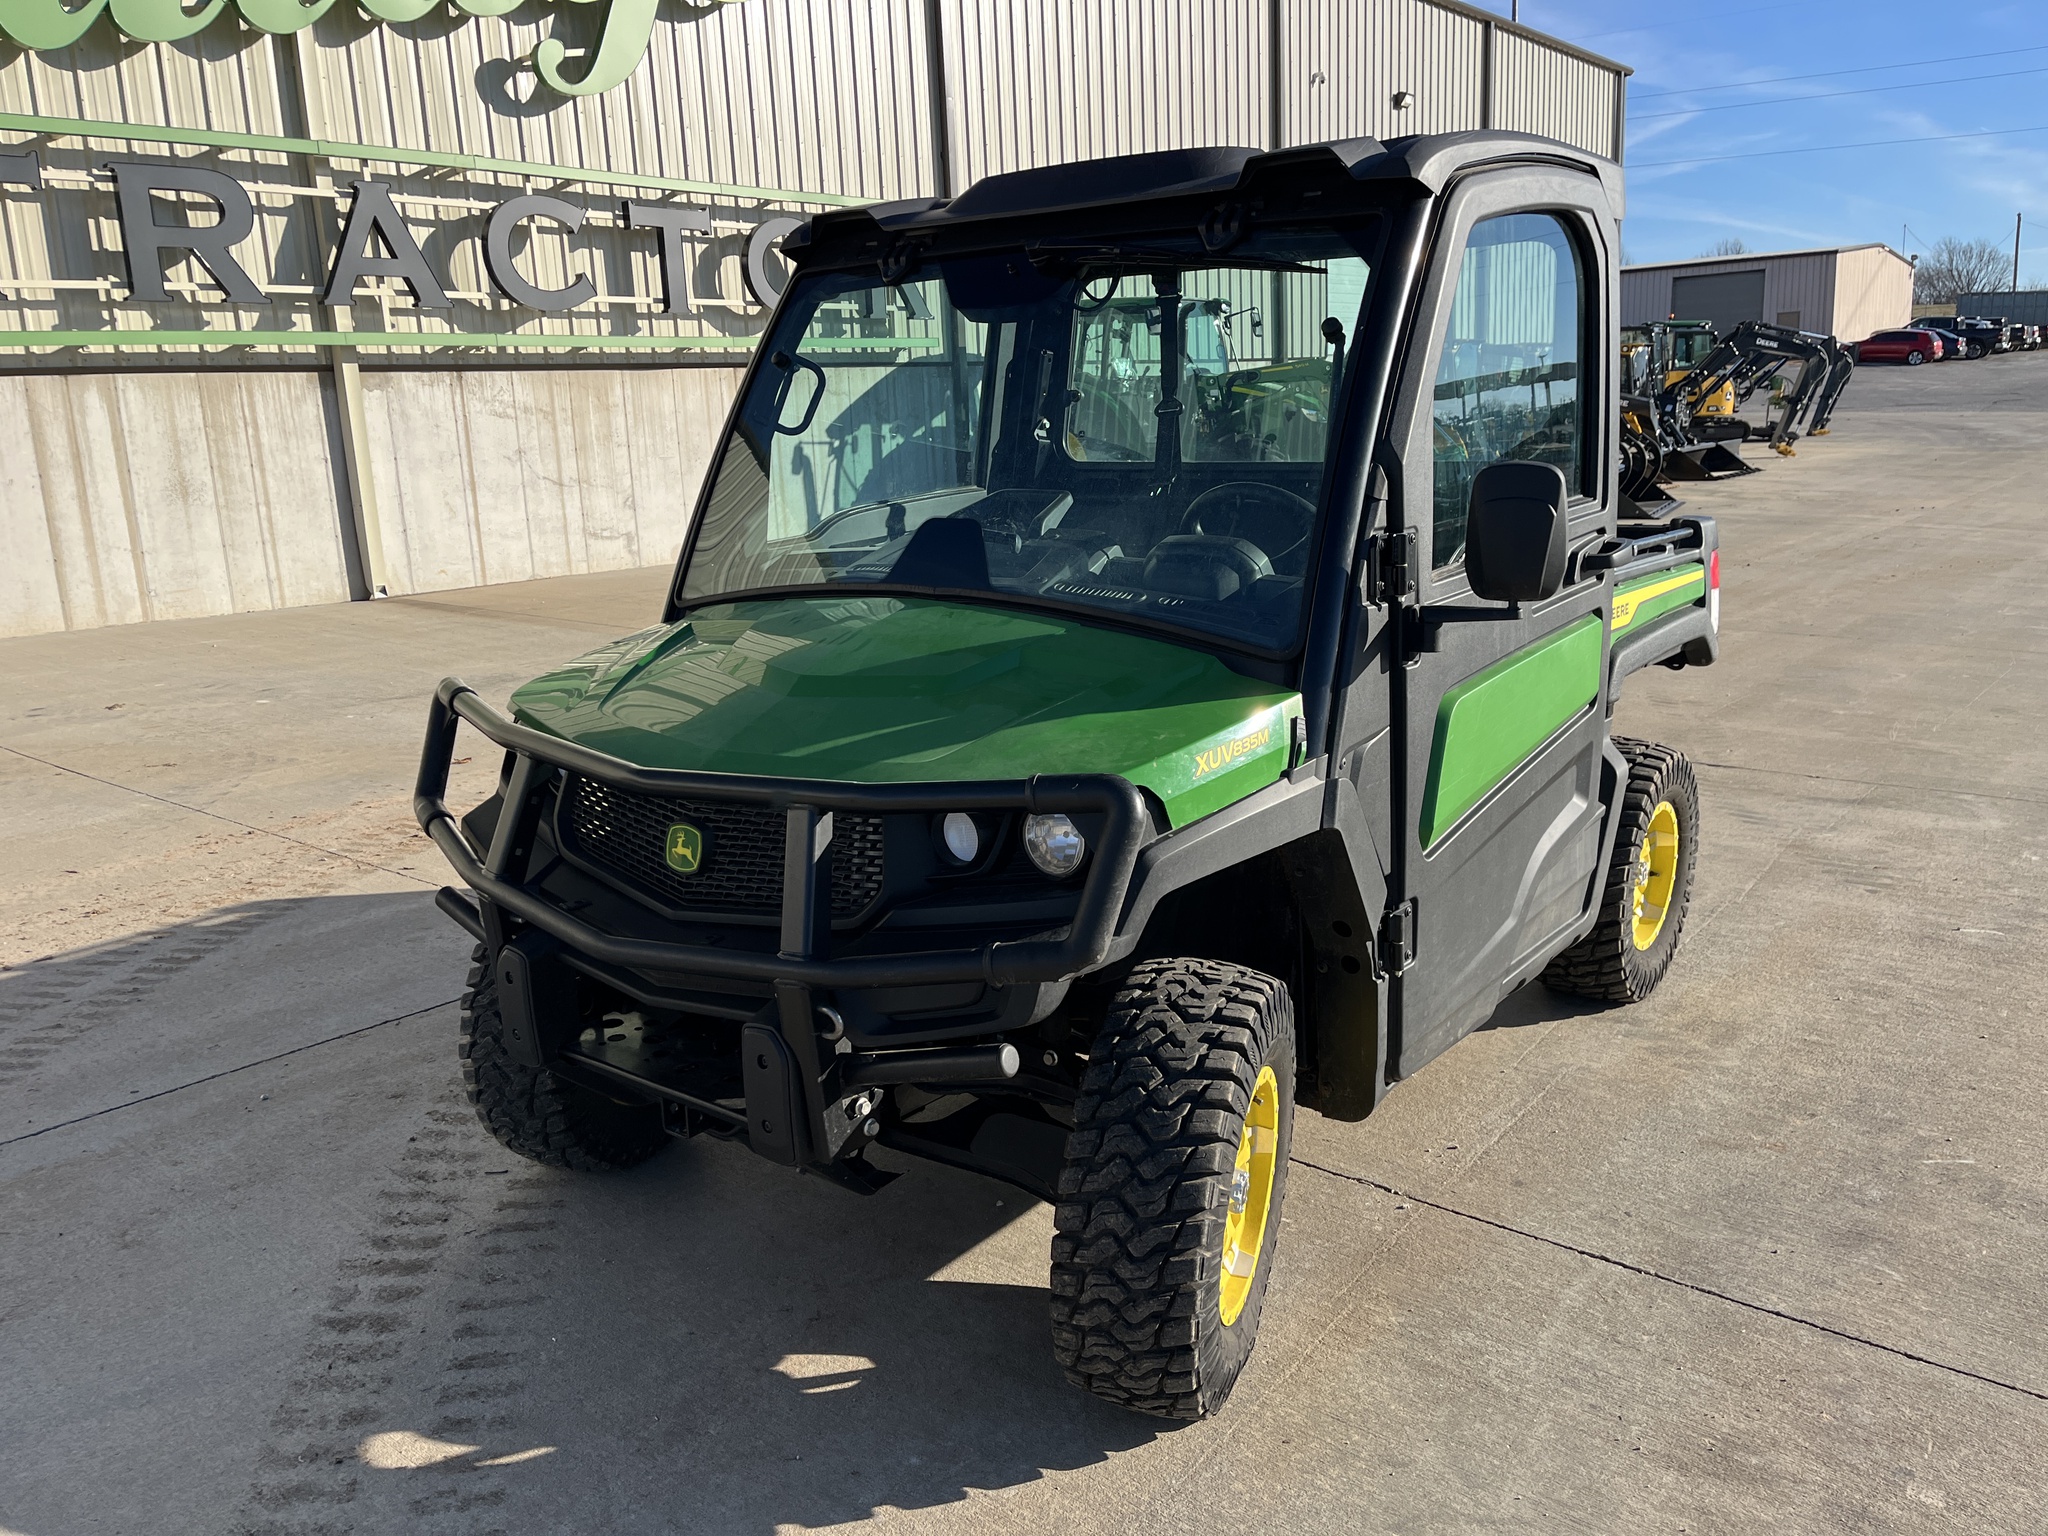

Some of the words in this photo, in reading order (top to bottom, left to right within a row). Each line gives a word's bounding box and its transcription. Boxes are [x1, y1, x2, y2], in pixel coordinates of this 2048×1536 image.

[1755, 337, 1779, 348] DEERE
[1611, 602, 1629, 619] EERE
[1193, 728, 1270, 779] XUV835M
